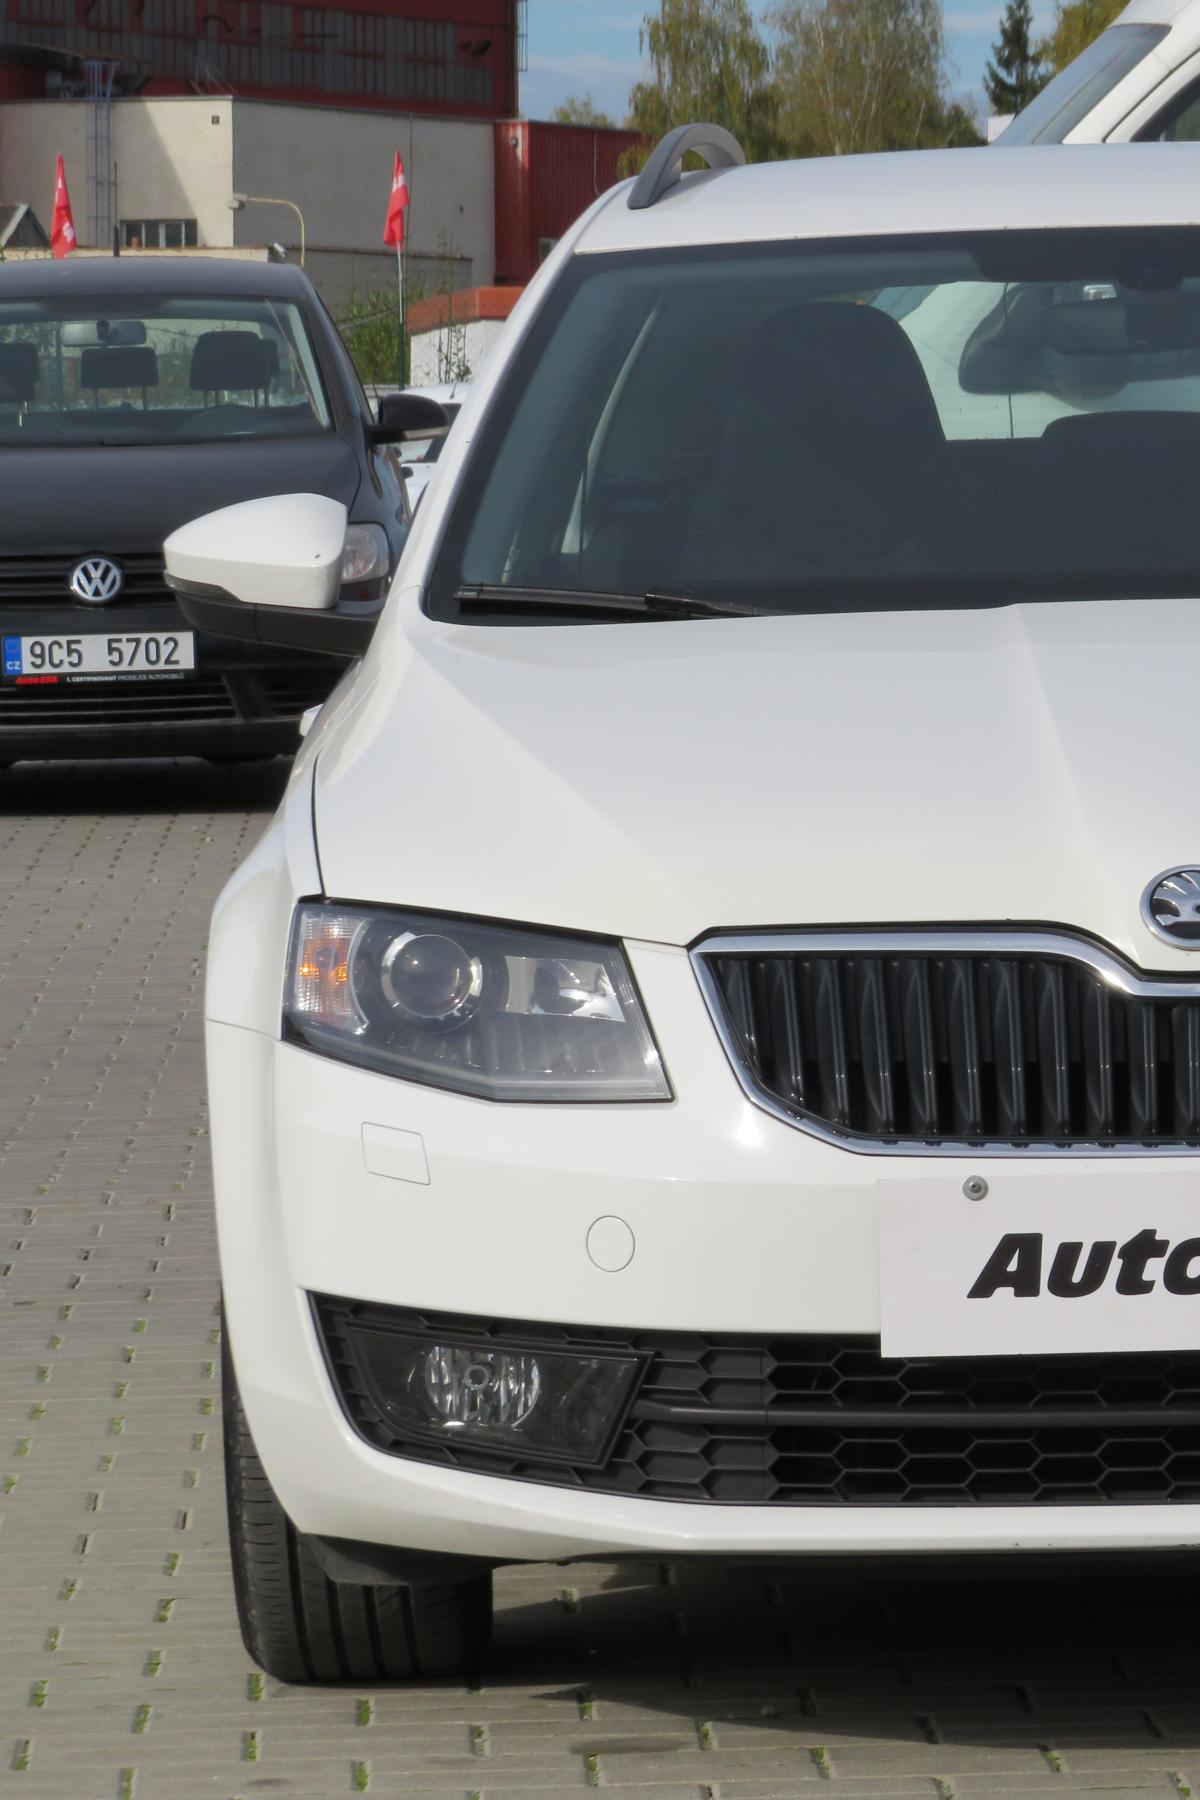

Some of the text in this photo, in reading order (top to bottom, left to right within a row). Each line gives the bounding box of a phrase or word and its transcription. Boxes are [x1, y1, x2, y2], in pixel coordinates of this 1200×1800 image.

[73, 558, 121, 601] VW
[6, 661, 21, 670] CZ
[30, 636, 180, 669] 9C5 5702
